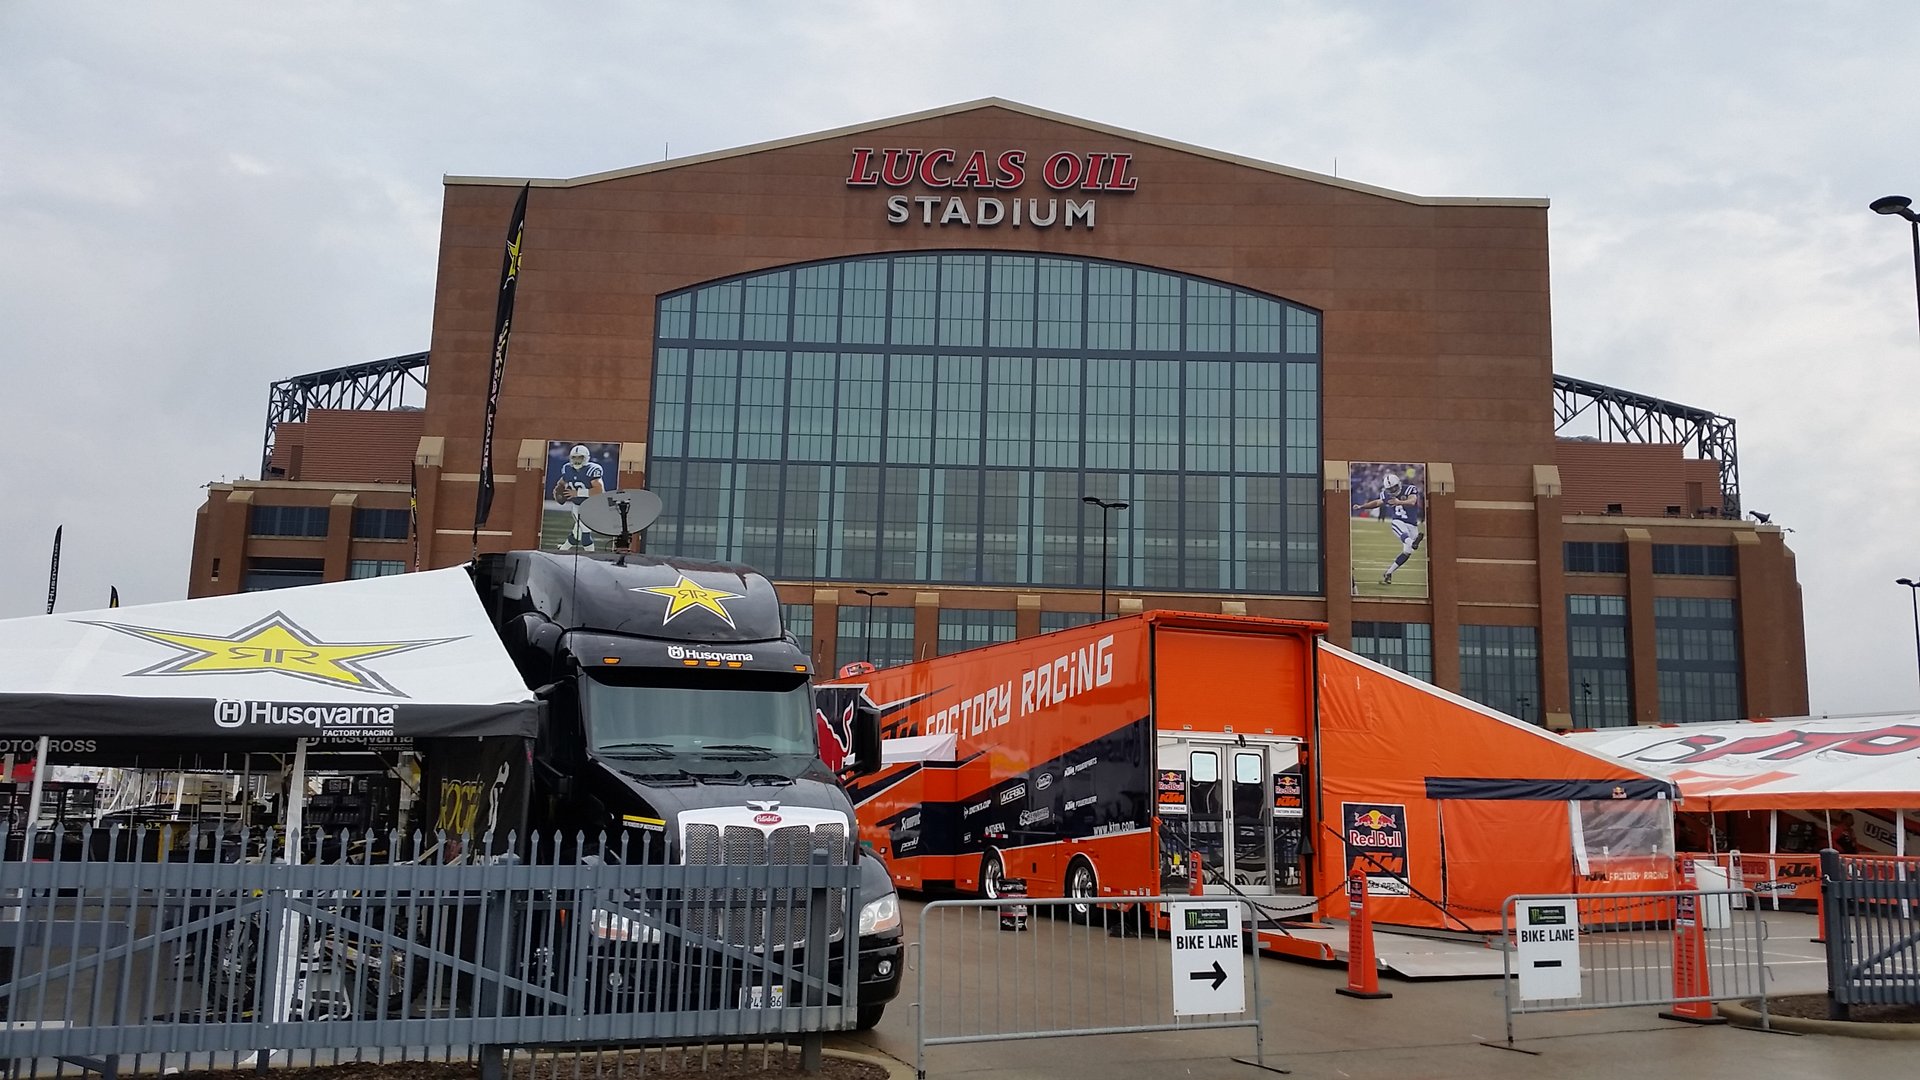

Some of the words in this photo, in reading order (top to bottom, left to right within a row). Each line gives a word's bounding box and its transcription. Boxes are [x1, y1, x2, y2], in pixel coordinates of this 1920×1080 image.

[846, 148, 1027, 189] LUCAS
[1043, 151, 1138, 191] OIL
[887, 195, 1096, 229] STADIUM
[685, 649, 753, 662] Husqvarna
[250, 701, 395, 728] Husqvarna
[926, 680, 1012, 740] FACTORY
[322, 729, 361, 737] FACTORY
[362, 729, 394, 737] RACING
[1093, 820, 1135, 836] www.ktm.com
[1348, 829, 1375, 847] Red
[1376, 830, 1403, 848] Bull
[1350, 852, 1404, 874] KTM
[1777, 862, 1818, 878] KTM
[1609, 872, 1640, 881] FACTORY
[1643, 871, 1669, 880] RACING
[1176, 935, 1204, 950] BIKE
[1208, 934, 1238, 949] LANE
[1521, 930, 1546, 943] BIKE
[1549, 929, 1575, 942] LANE
